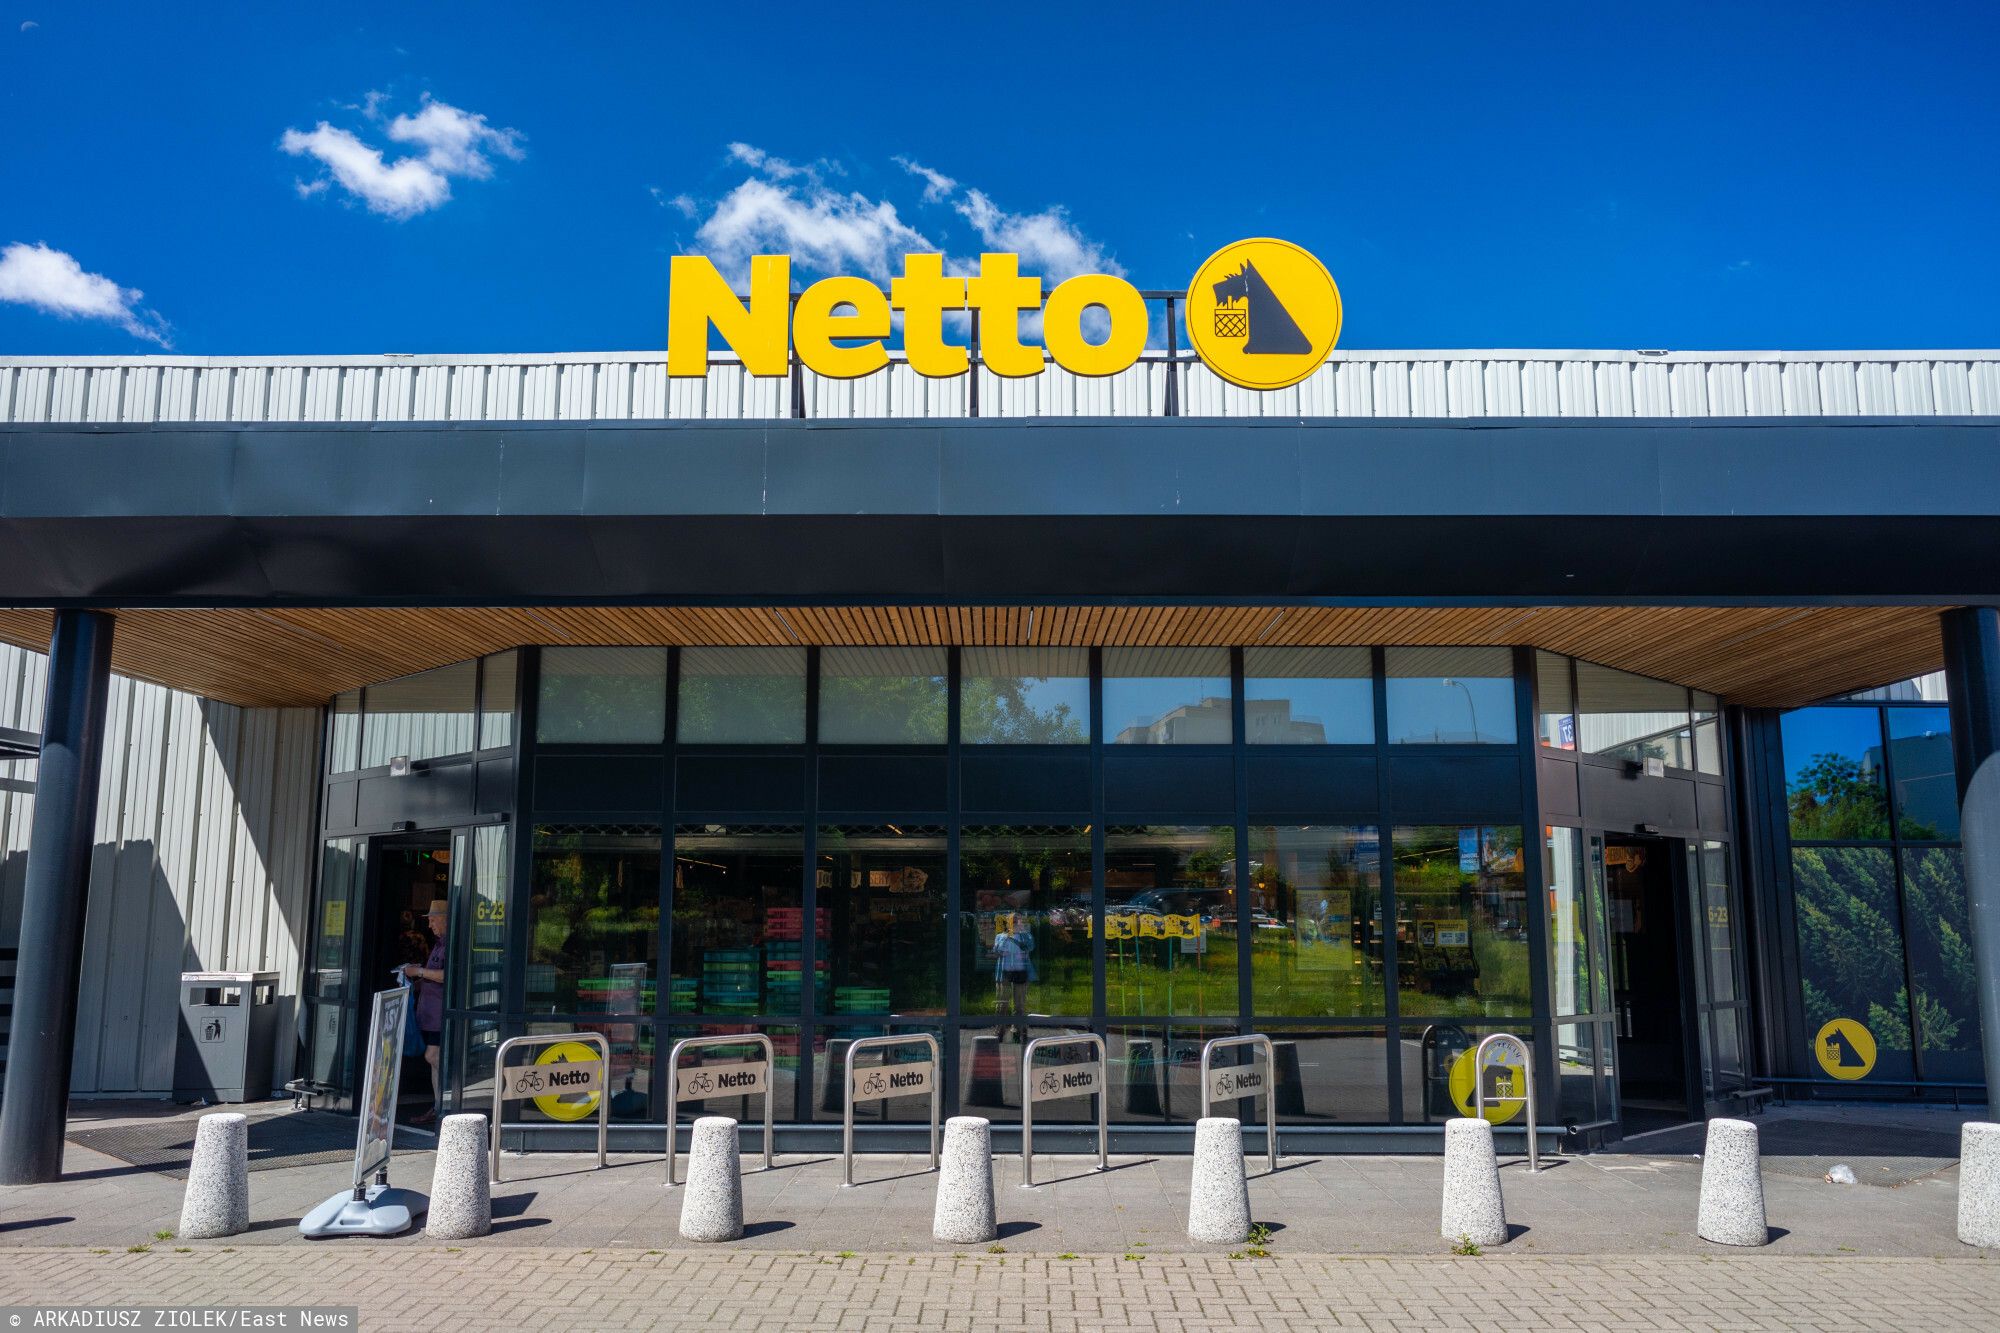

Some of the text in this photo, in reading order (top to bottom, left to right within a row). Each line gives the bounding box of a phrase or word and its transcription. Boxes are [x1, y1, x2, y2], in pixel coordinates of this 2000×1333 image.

[668, 252, 1149, 379] Netto
[477, 901, 505, 920] 6-23
[1707, 906, 1729, 922] 6-23
[549, 1070, 590, 1087] Netto
[717, 1071, 756, 1087] Netto
[889, 1072, 924, 1088] Netto
[1062, 1072, 1093, 1088] Netto
[1235, 1072, 1262, 1089] Netto
